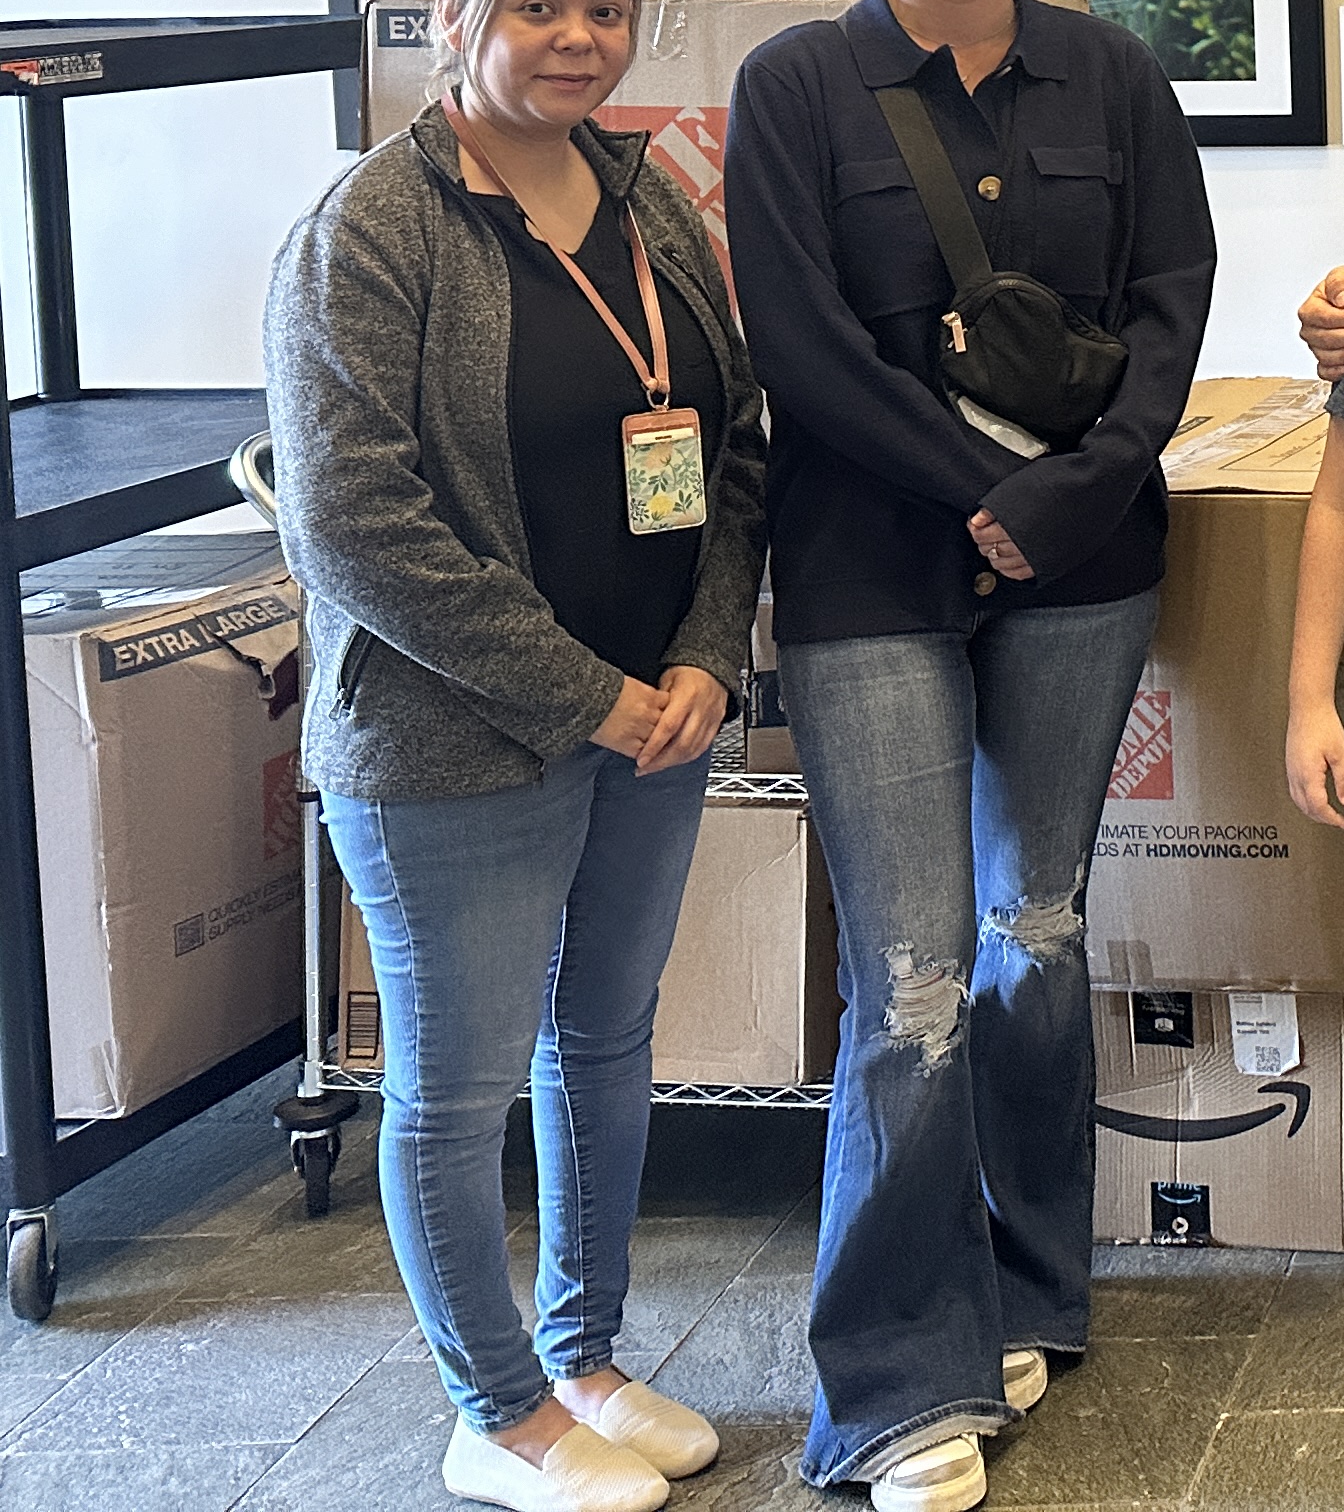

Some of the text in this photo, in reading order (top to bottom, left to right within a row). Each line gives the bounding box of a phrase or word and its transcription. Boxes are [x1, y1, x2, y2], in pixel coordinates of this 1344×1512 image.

[112, 600, 286, 671] EXTRA LARGE
[1151, 824, 1199, 839] YOUR
[1204, 825, 1278, 839] PACKING
[1122, 843, 1142, 857] AT
[1146, 843, 1289, 858] HDMOVING.COM
